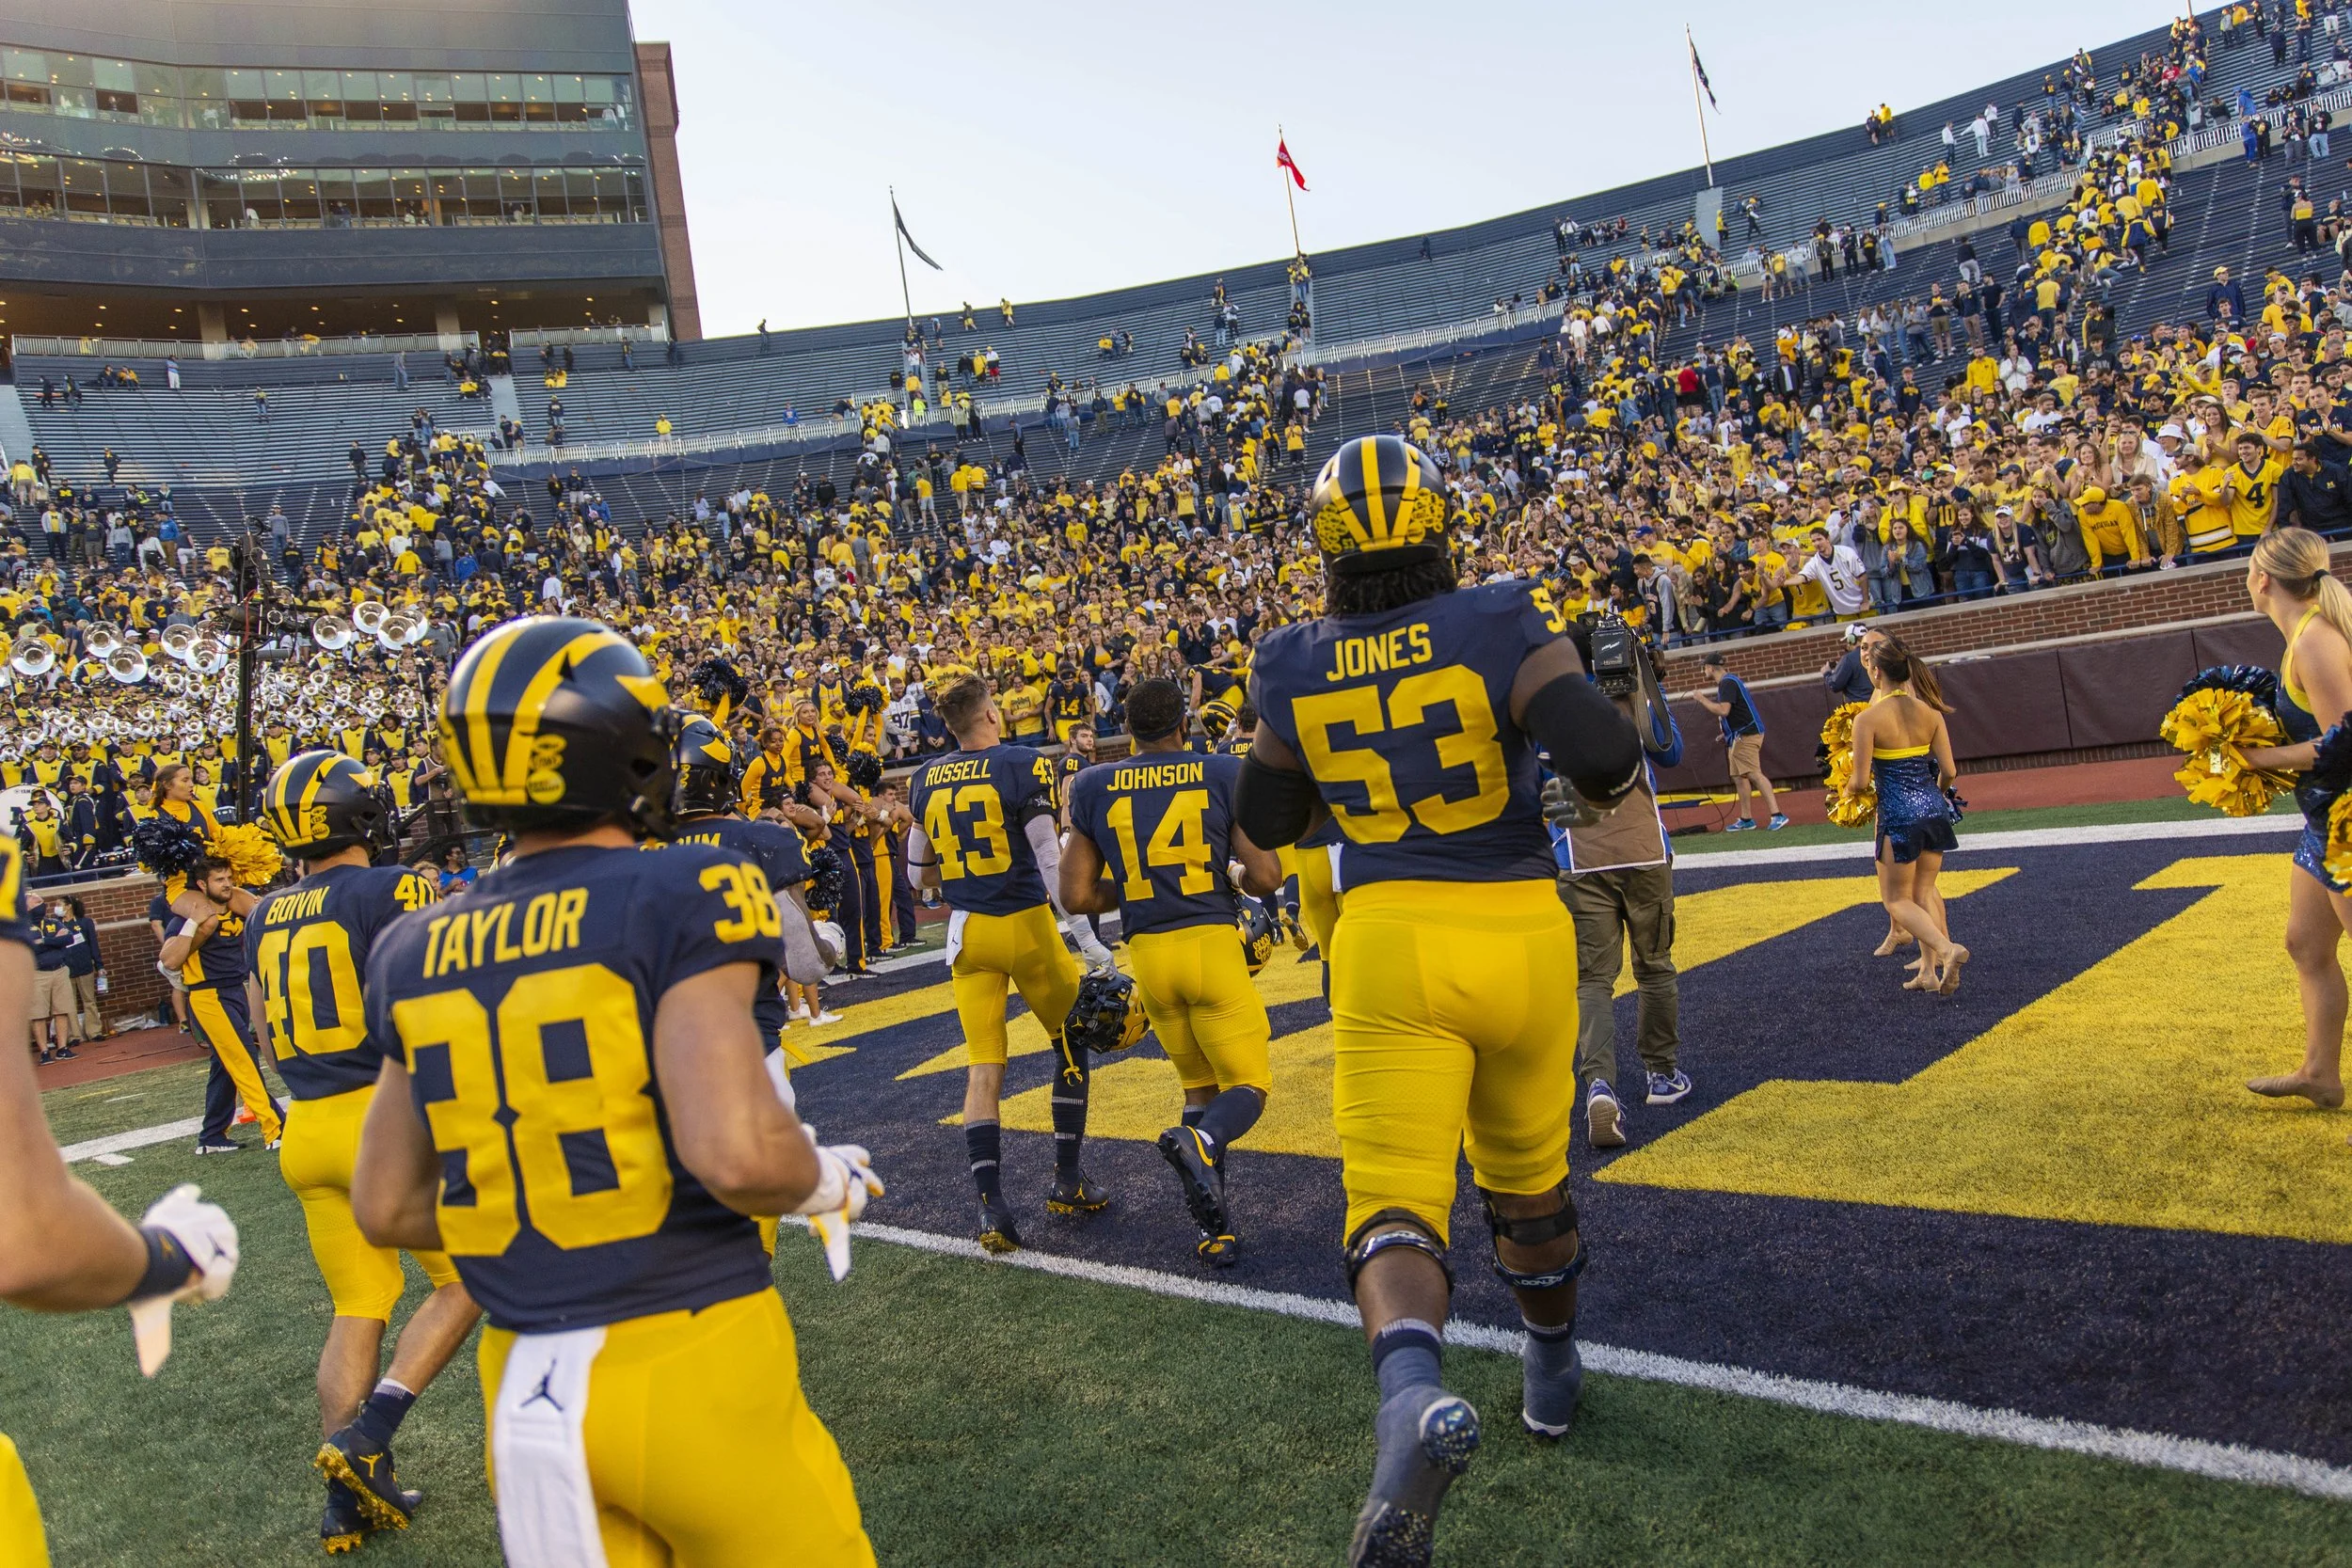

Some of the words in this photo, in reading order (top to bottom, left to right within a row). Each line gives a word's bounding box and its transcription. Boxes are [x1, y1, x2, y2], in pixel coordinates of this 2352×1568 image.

[1519, 432, 1532, 442] M
[2246, 483, 2265, 509] 4
[1938, 504, 1956, 527] 10
[537, 557, 550, 570] 55
[1829, 571, 1844, 592] 5
[524, 590, 534, 605] 2
[805, 604, 813, 615] 9
[1529, 587, 1568, 634] 5
[156, 606, 167, 618] 2
[1326, 623, 1433, 682] JONES
[892, 711, 910, 729] 97
[1060, 699, 1080, 716] 14
[809, 744, 820, 755] M
[1292, 664, 1511, 845] 53
[925, 758, 992, 787] RUSSELL
[1032, 756, 1055, 784] 43
[1065, 758, 1078, 771] 81
[1106, 761, 1204, 791] JOHNSON
[771, 776, 783, 787] M
[924, 784, 1012, 880] 43
[1106, 789, 1215, 901] 14
[264, 886, 330, 926] BOIVIN
[393, 874, 435, 911] 40
[698, 862, 782, 943] 38
[218, 915, 244, 937] M
[422, 887, 589, 979] TAYLOR
[257, 920, 369, 1061] 40
[391, 962, 675, 1257] 38
